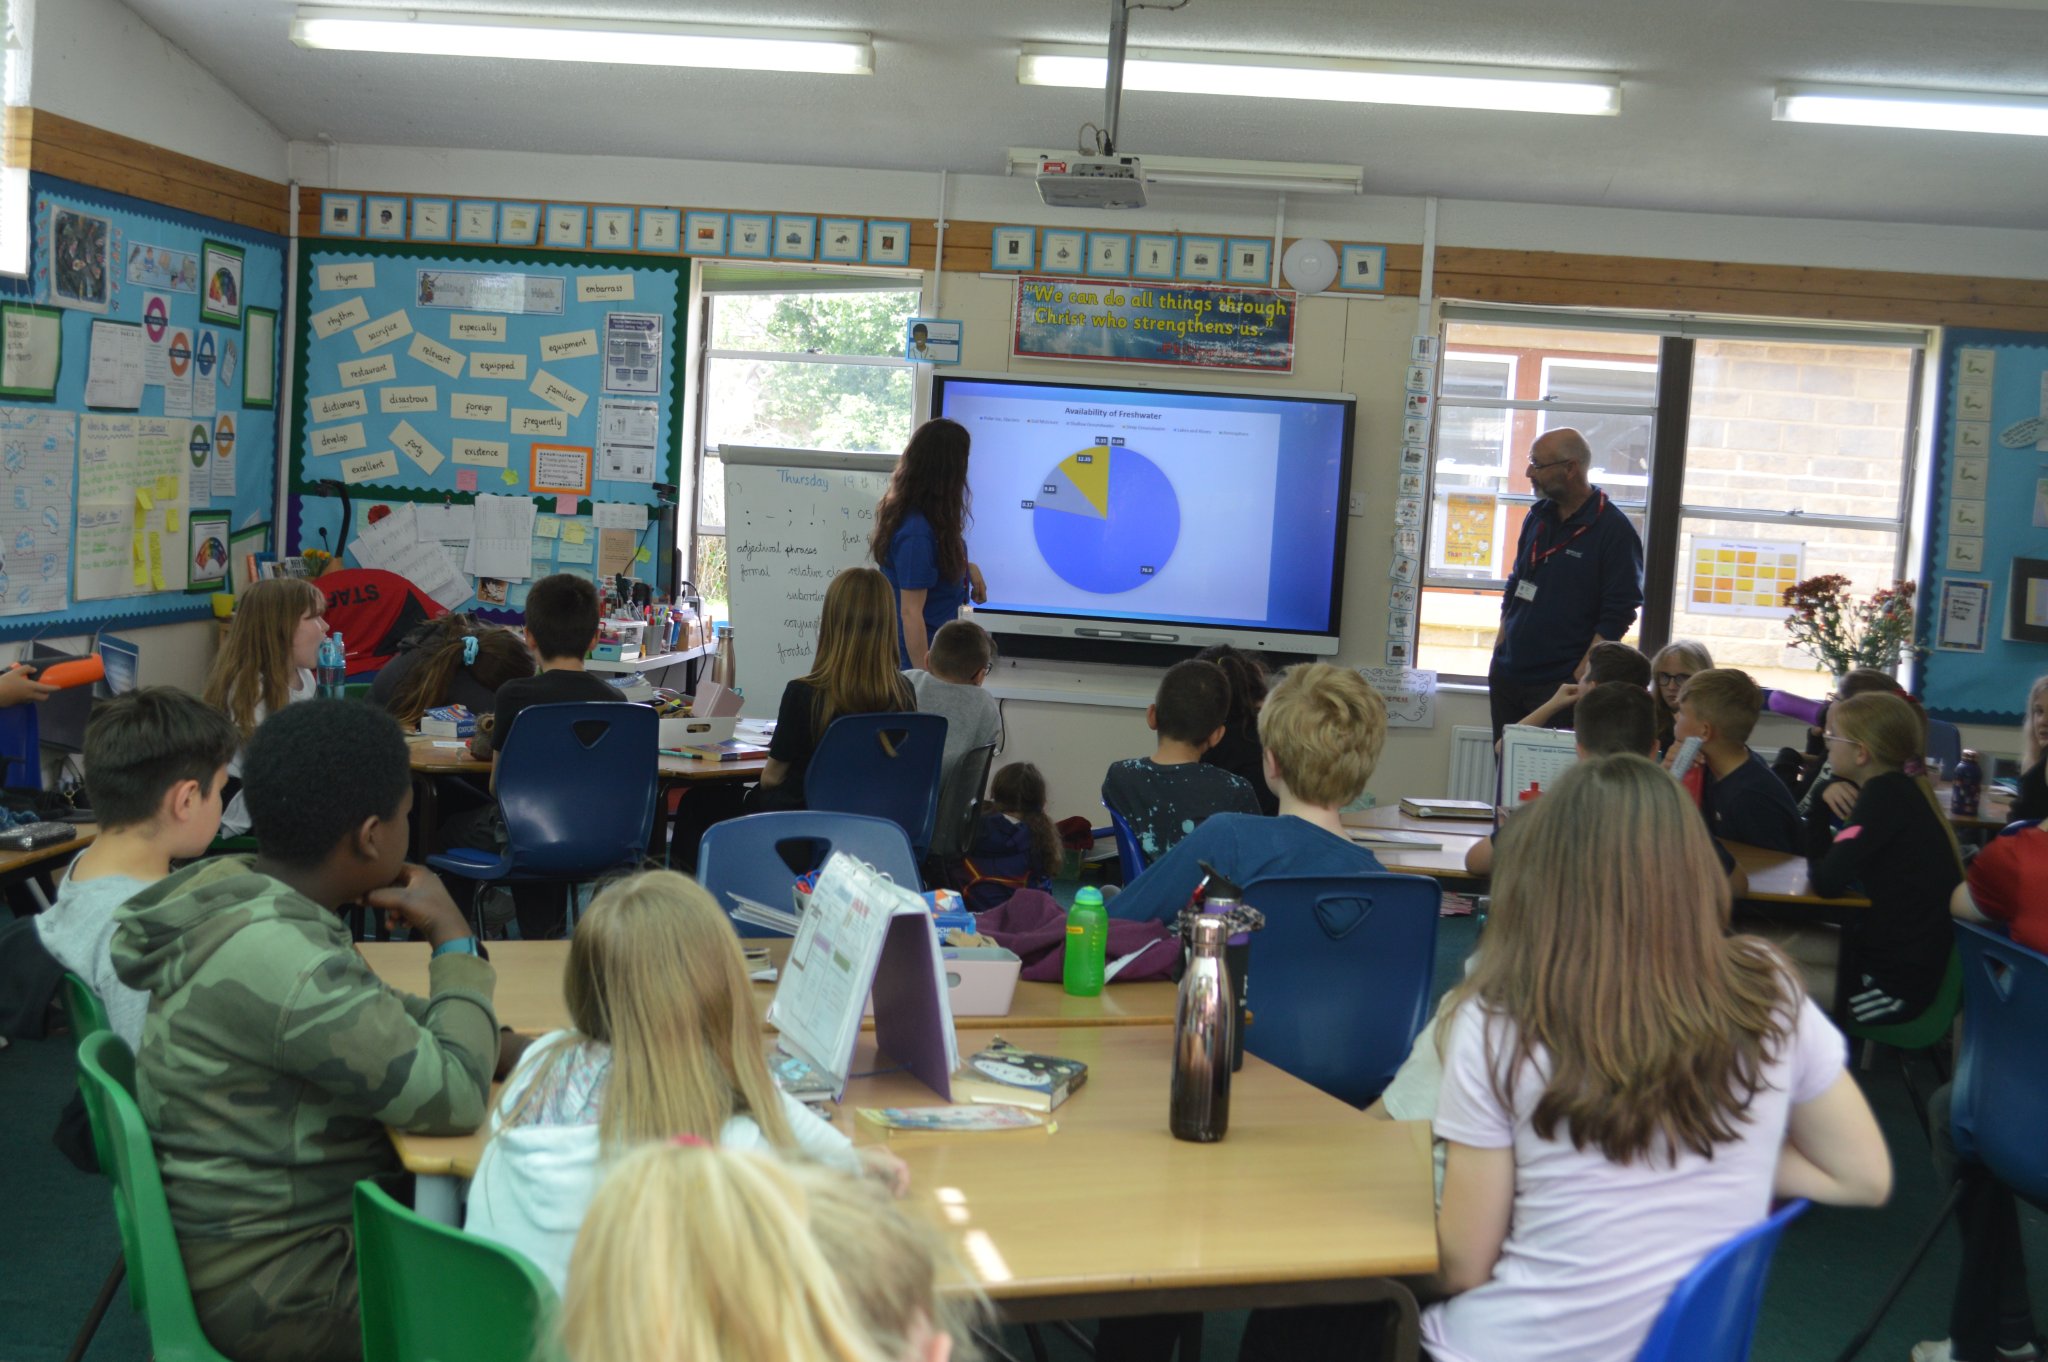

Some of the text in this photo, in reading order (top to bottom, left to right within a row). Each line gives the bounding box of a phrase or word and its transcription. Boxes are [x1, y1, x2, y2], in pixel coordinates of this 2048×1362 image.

[335, 272, 359, 285] rhyme
[585, 284, 623, 294] embarrass
[1068, 291, 1098, 306] can
[1103, 288, 1126, 307] do
[1130, 291, 1153, 308] all
[1159, 292, 1213, 317] things
[1217, 295, 1287, 321] through
[327, 310, 355, 327] rhythm
[1034, 306, 1087, 327] Christ
[1091, 310, 1128, 329] who
[1133, 314, 1234, 339] strengthens
[368, 322, 399, 342] sacrifice
[459, 323, 497, 336] especially
[548, 336, 588, 354] equipment
[422, 345, 451, 365] relevant
[350, 363, 387, 379] restaurant
[480, 360, 516, 372] equipped
[389, 394, 429, 404] disastrous
[545, 384, 577, 404] familiar
[322, 399, 360, 414] dictionary
[465, 402, 493, 415] foreign
[1064, 407, 1162, 420] Availability of Freshwater
[523, 417, 562, 430] frequently
[321, 433, 348, 447] develop
[404, 439, 423, 458] forty
[464, 447, 499, 457] existence
[351, 458, 385, 474] excellent
[776, 469, 829, 493] Thursday
[841, 529, 861, 552] first
[736, 539, 818, 561] adjectival phrases
[740, 563, 842, 583] formal relative cla
[326, 584, 381, 609] STAF
[776, 640, 813, 665] fronted
